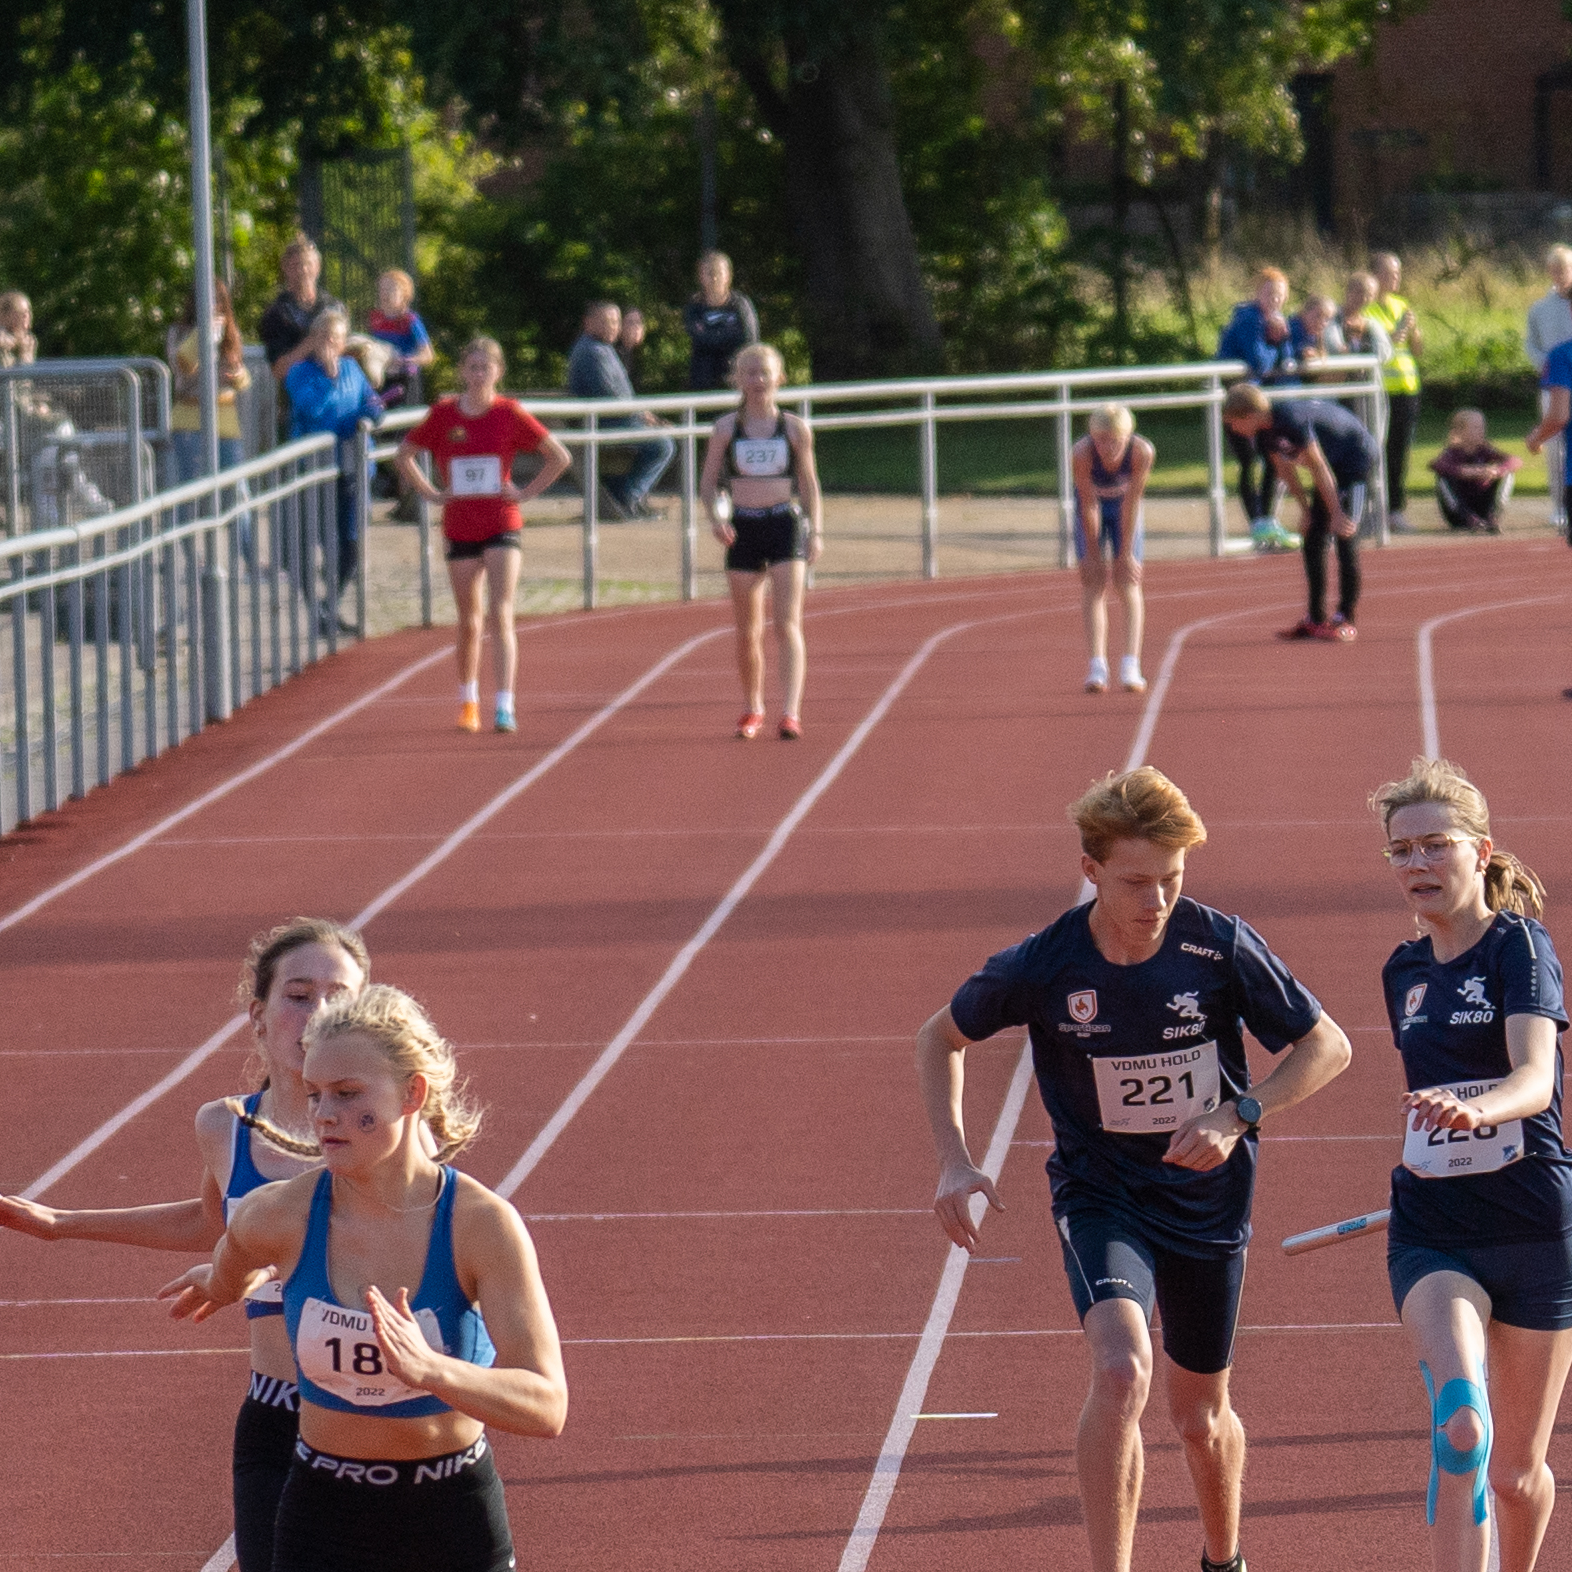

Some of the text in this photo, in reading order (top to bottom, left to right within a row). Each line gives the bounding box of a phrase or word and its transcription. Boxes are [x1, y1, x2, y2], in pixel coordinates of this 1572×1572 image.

[745, 449, 777, 464] 237
[465, 468, 486, 482] 97
[1180, 942, 1215, 959] CRAFT
[1449, 1010, 1495, 1026] SIK80
[1162, 1021, 1206, 1041] SIK80
[1110, 1049, 1202, 1072] VDMU HOLD
[1119, 1070, 1196, 1107] 221
[1152, 1115, 1177, 1126] 2022
[1448, 1157, 1473, 1168] 2022
[246, 1370, 301, 1414] NIK
[355, 1386, 386, 1397] 2022
[311, 1432, 488, 1486] PRO NIKE
